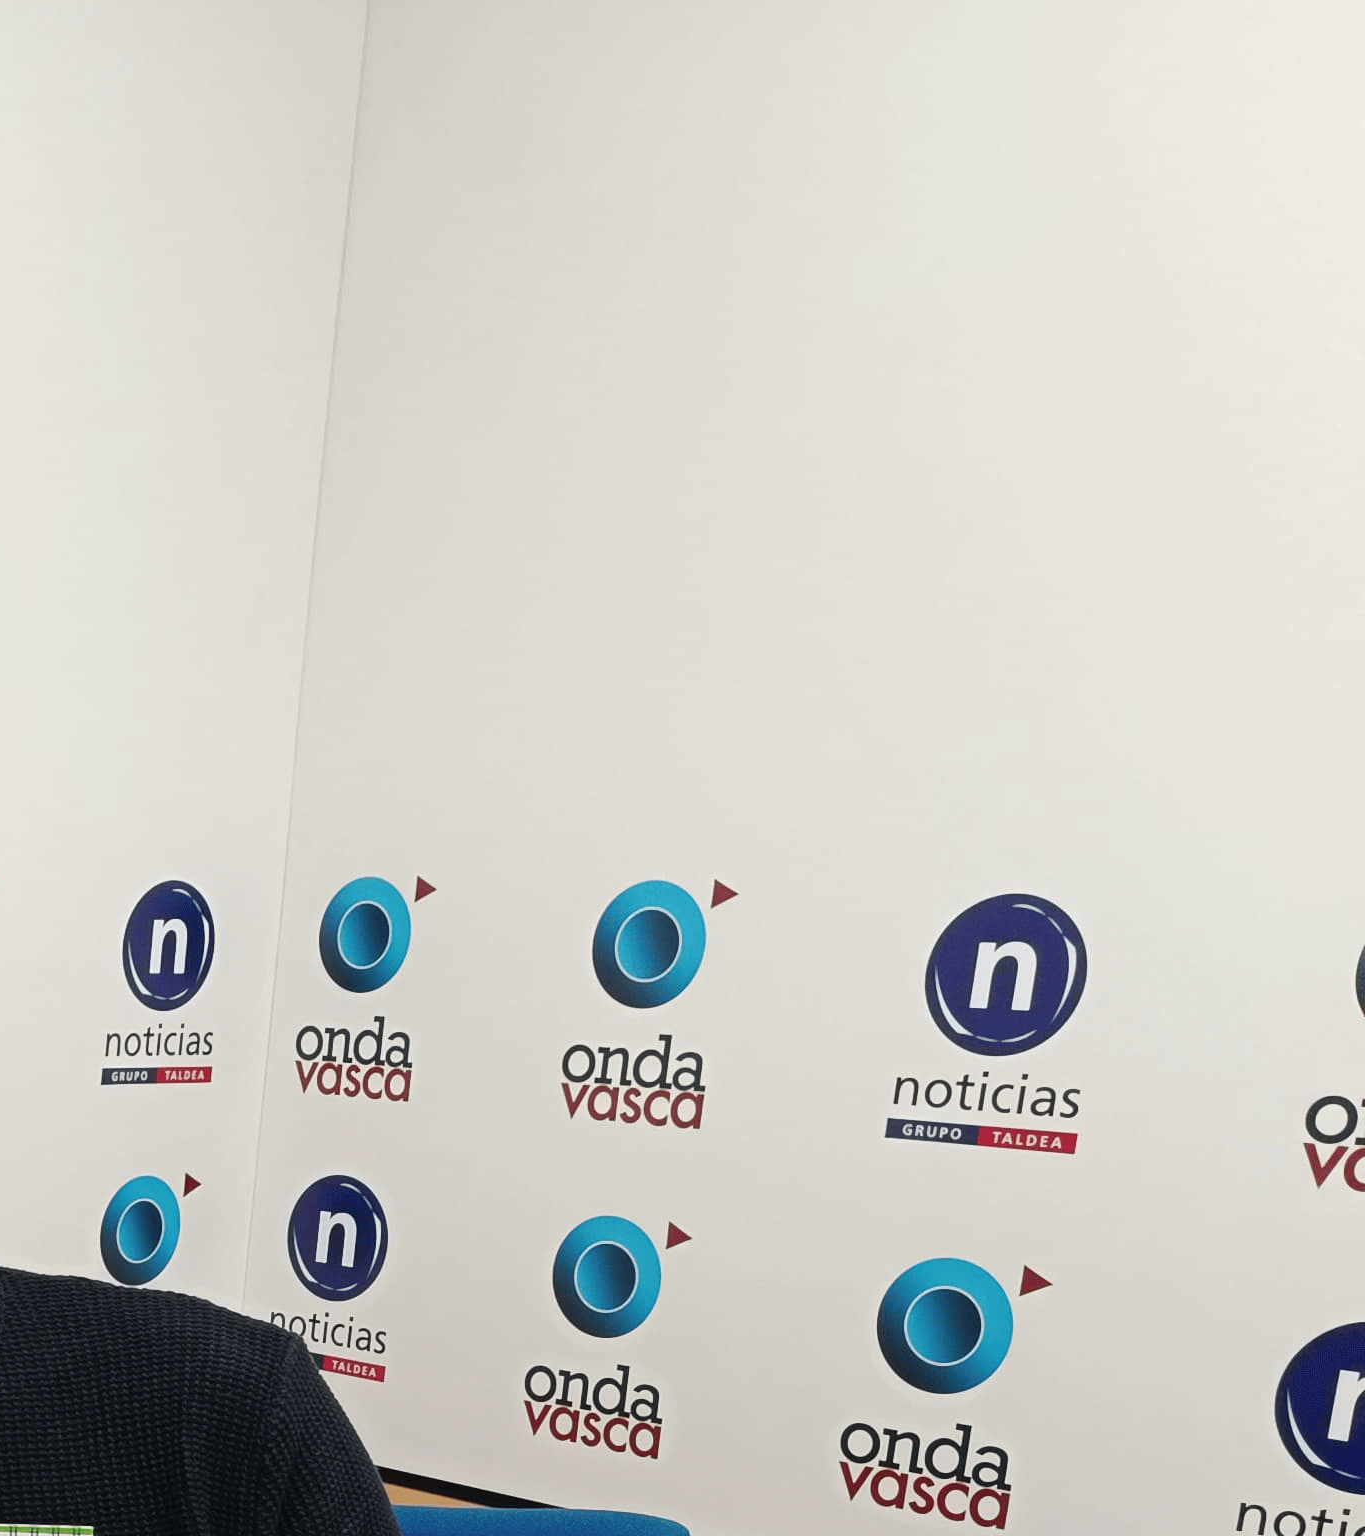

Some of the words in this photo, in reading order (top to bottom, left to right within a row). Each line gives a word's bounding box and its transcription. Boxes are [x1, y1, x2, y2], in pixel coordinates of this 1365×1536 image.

[105, 1023, 213, 1057] noticias
[295, 1016, 413, 1067] onda
[561, 1034, 706, 1093] onda
[111, 1070, 149, 1082] GRUPO
[164, 1069, 205, 1081] TALDEA
[294, 1060, 412, 1102] vasca
[893, 1071, 1081, 1119] noticias
[561, 1082, 704, 1129] vasca
[901, 1123, 963, 1140] GRUPO
[991, 1131, 1063, 1149] TALDEA
[270, 1311, 387, 1354] noticias
[331, 1359, 378, 1378] TALDEA
[523, 1364, 663, 1424] onda
[523, 1400, 662, 1460] vasca
[839, 1422, 1012, 1491] onda
[839, 1461, 1011, 1530] vasca
